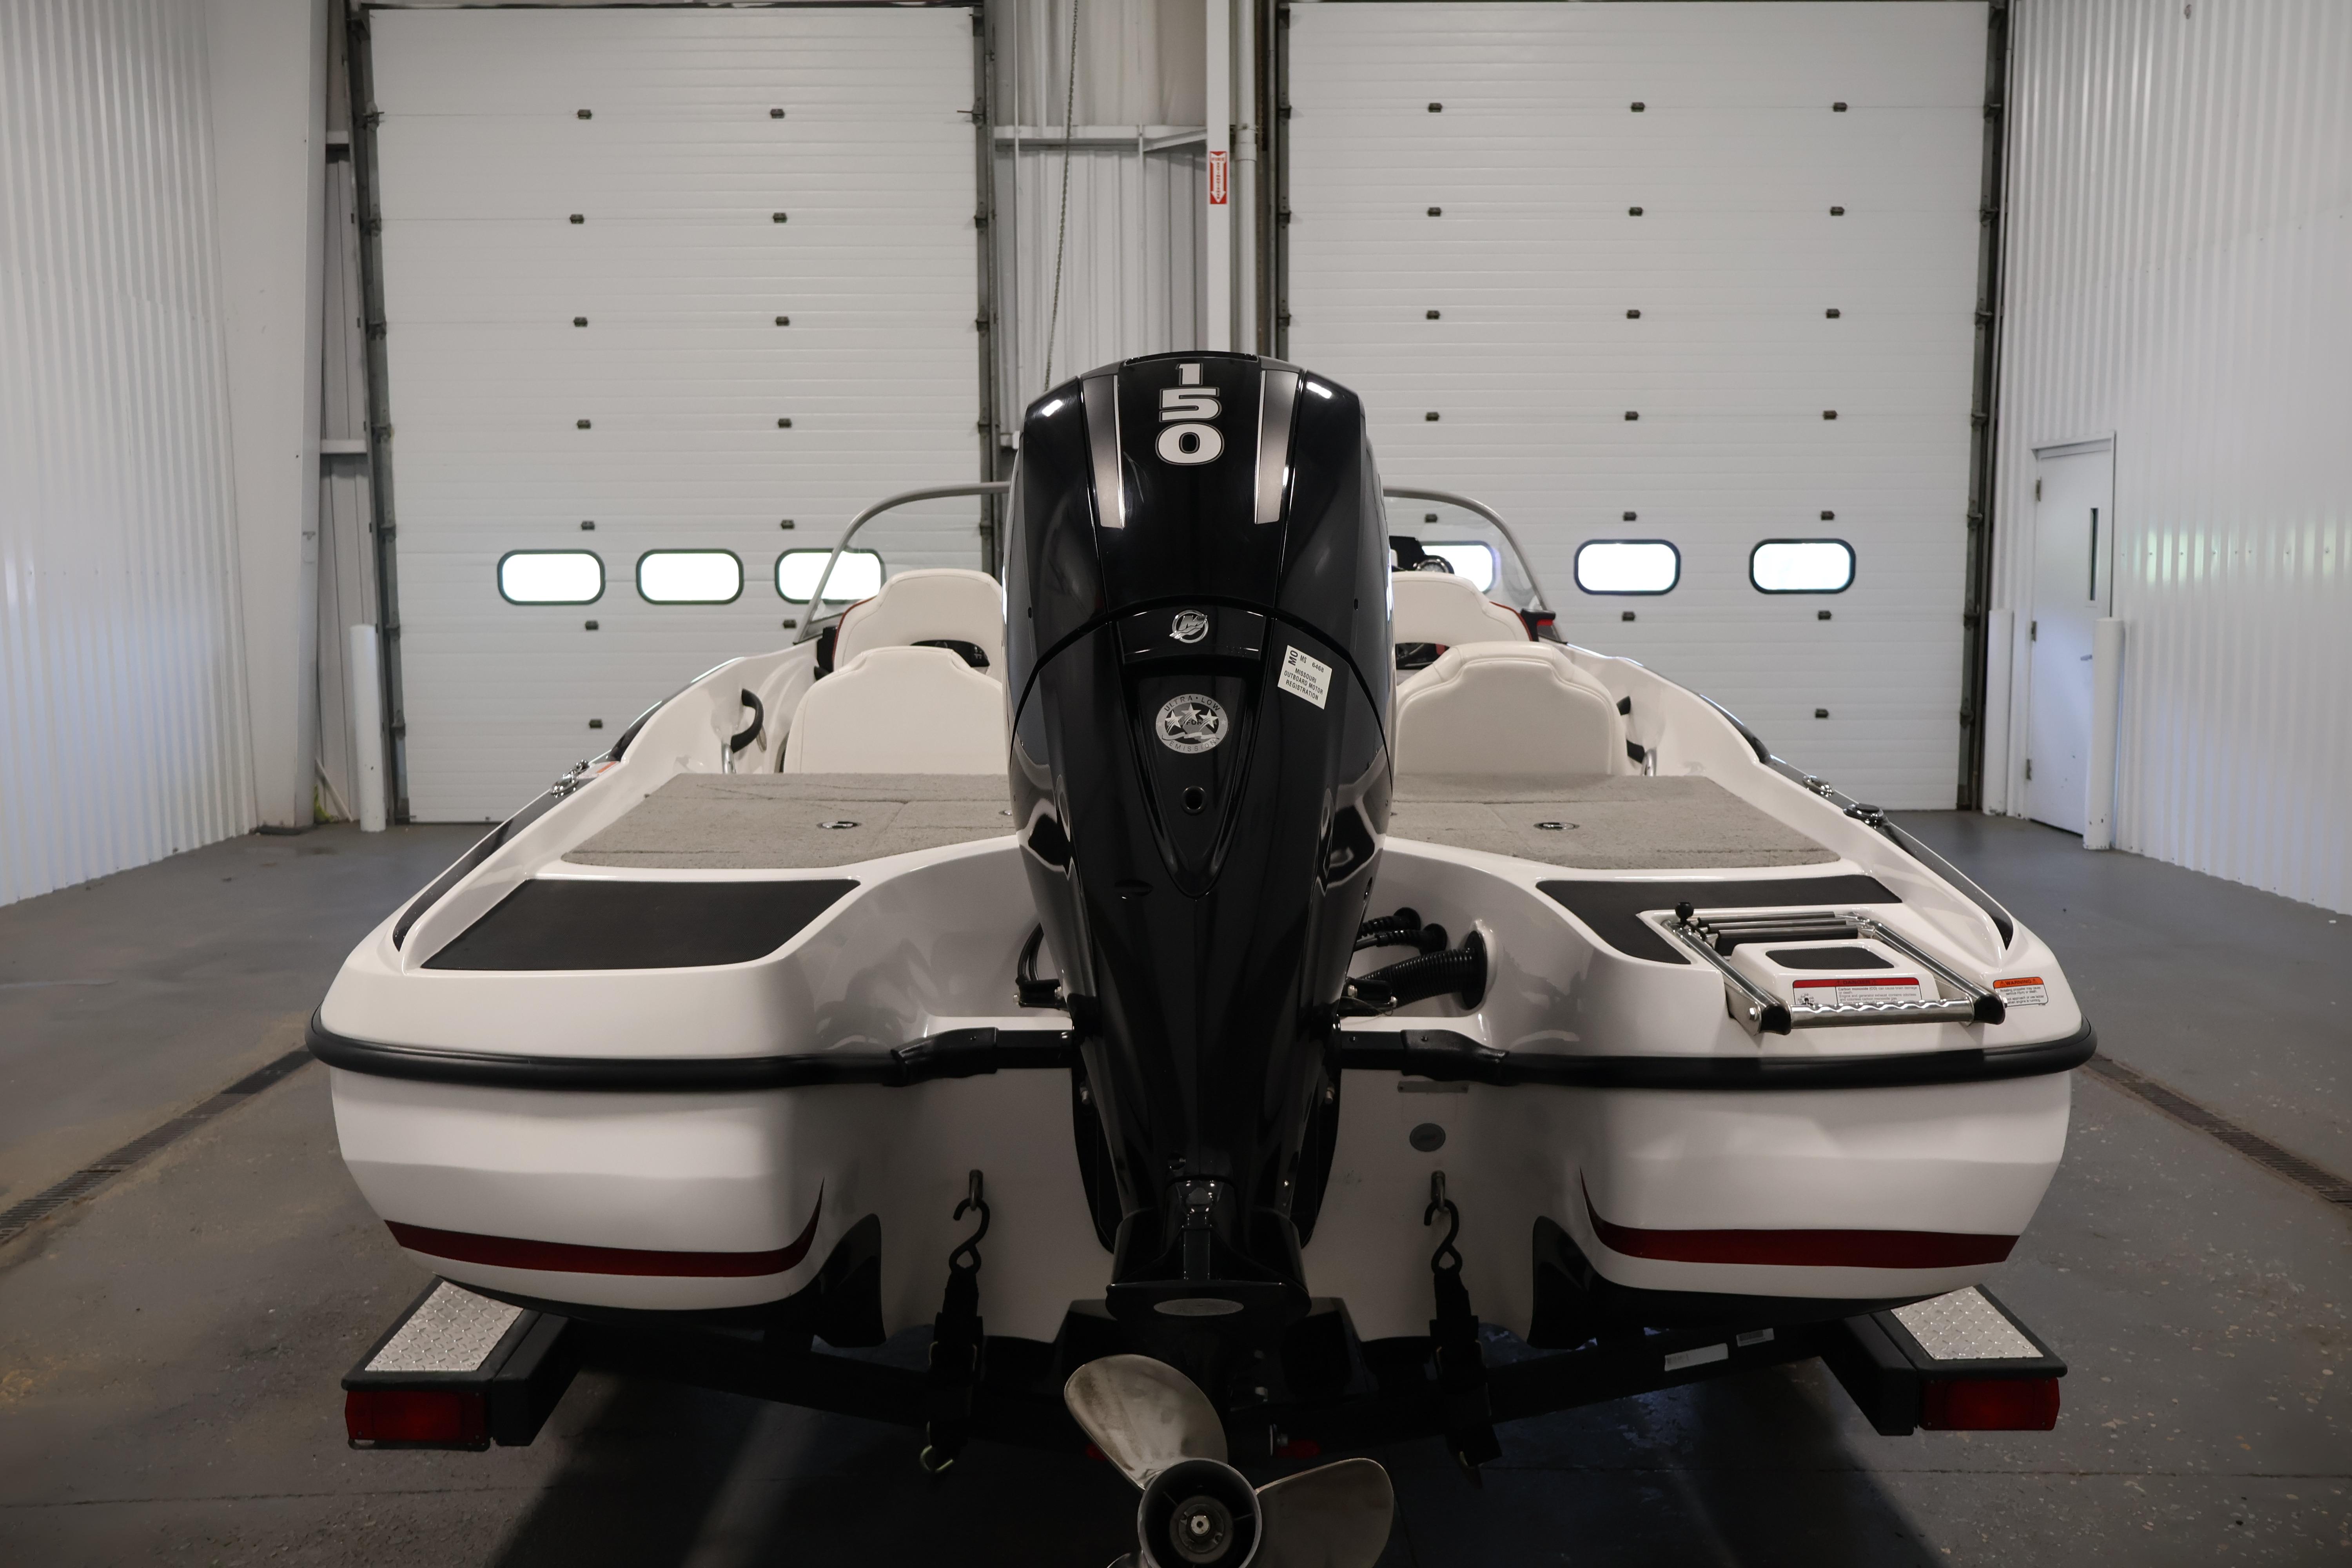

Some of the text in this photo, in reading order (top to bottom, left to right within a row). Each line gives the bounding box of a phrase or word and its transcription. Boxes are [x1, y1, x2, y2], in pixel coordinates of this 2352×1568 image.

[1155, 363, 1225, 466] 150
[1288, 650, 1298, 666] MO
[1300, 655, 1324, 673] MS 6468
[1284, 670, 1323, 695] OUTBOARD MOTOR
[1295, 668, 1316, 683] MISSOURI
[1286, 679, 1319, 701] REGISTRATION
[1164, 695, 1220, 712] ULTRA LOW
[1169, 739, 1216, 752] EMISSION
